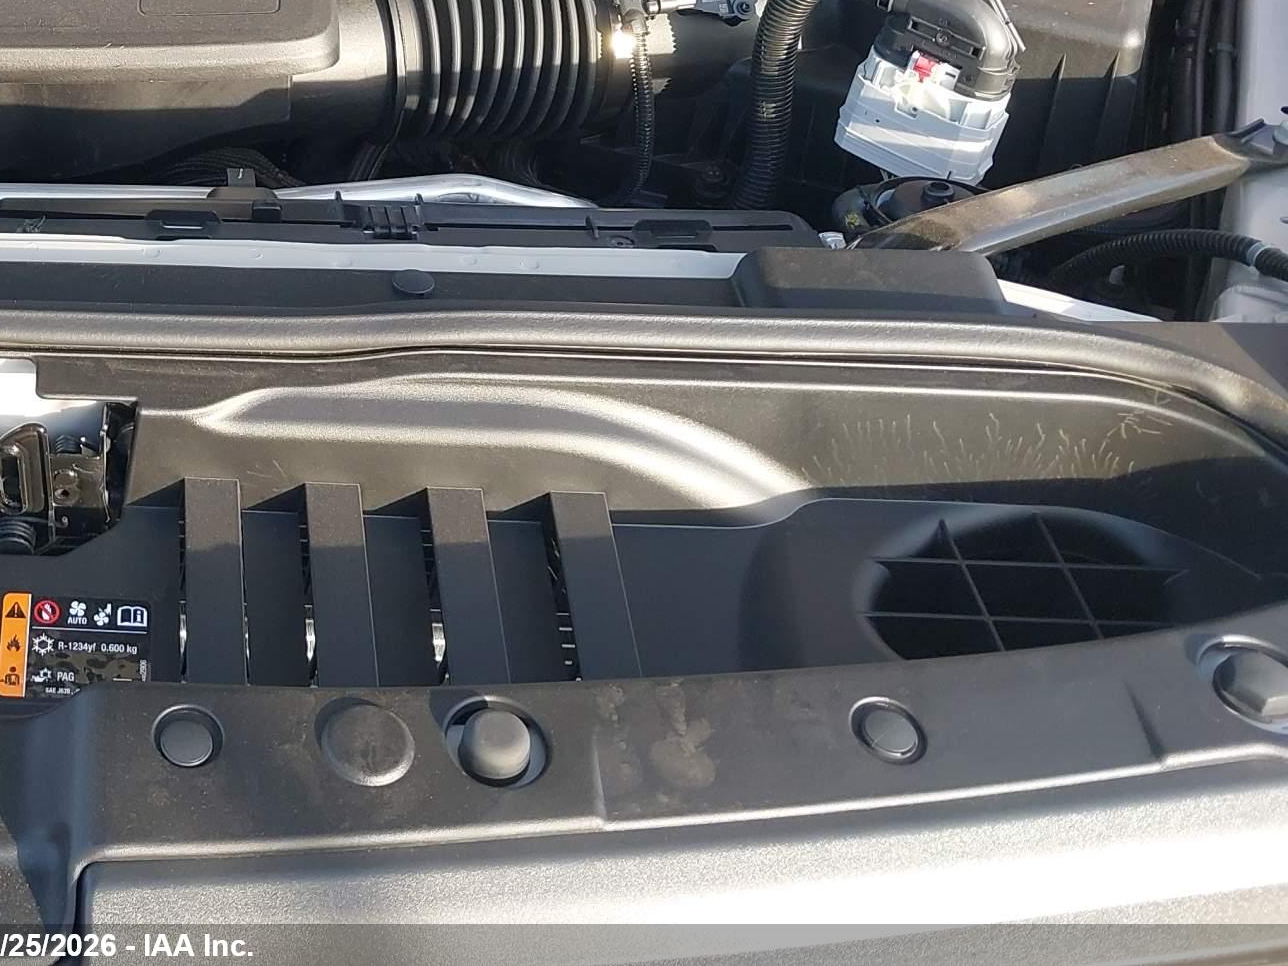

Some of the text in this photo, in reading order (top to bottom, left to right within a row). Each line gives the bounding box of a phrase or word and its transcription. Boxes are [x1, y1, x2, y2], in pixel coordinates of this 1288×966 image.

[67, 616, 87, 625] AUTO
[57, 641, 138, 655] R-1234yf 0.600 kg
[56, 671, 75, 682] PAG
